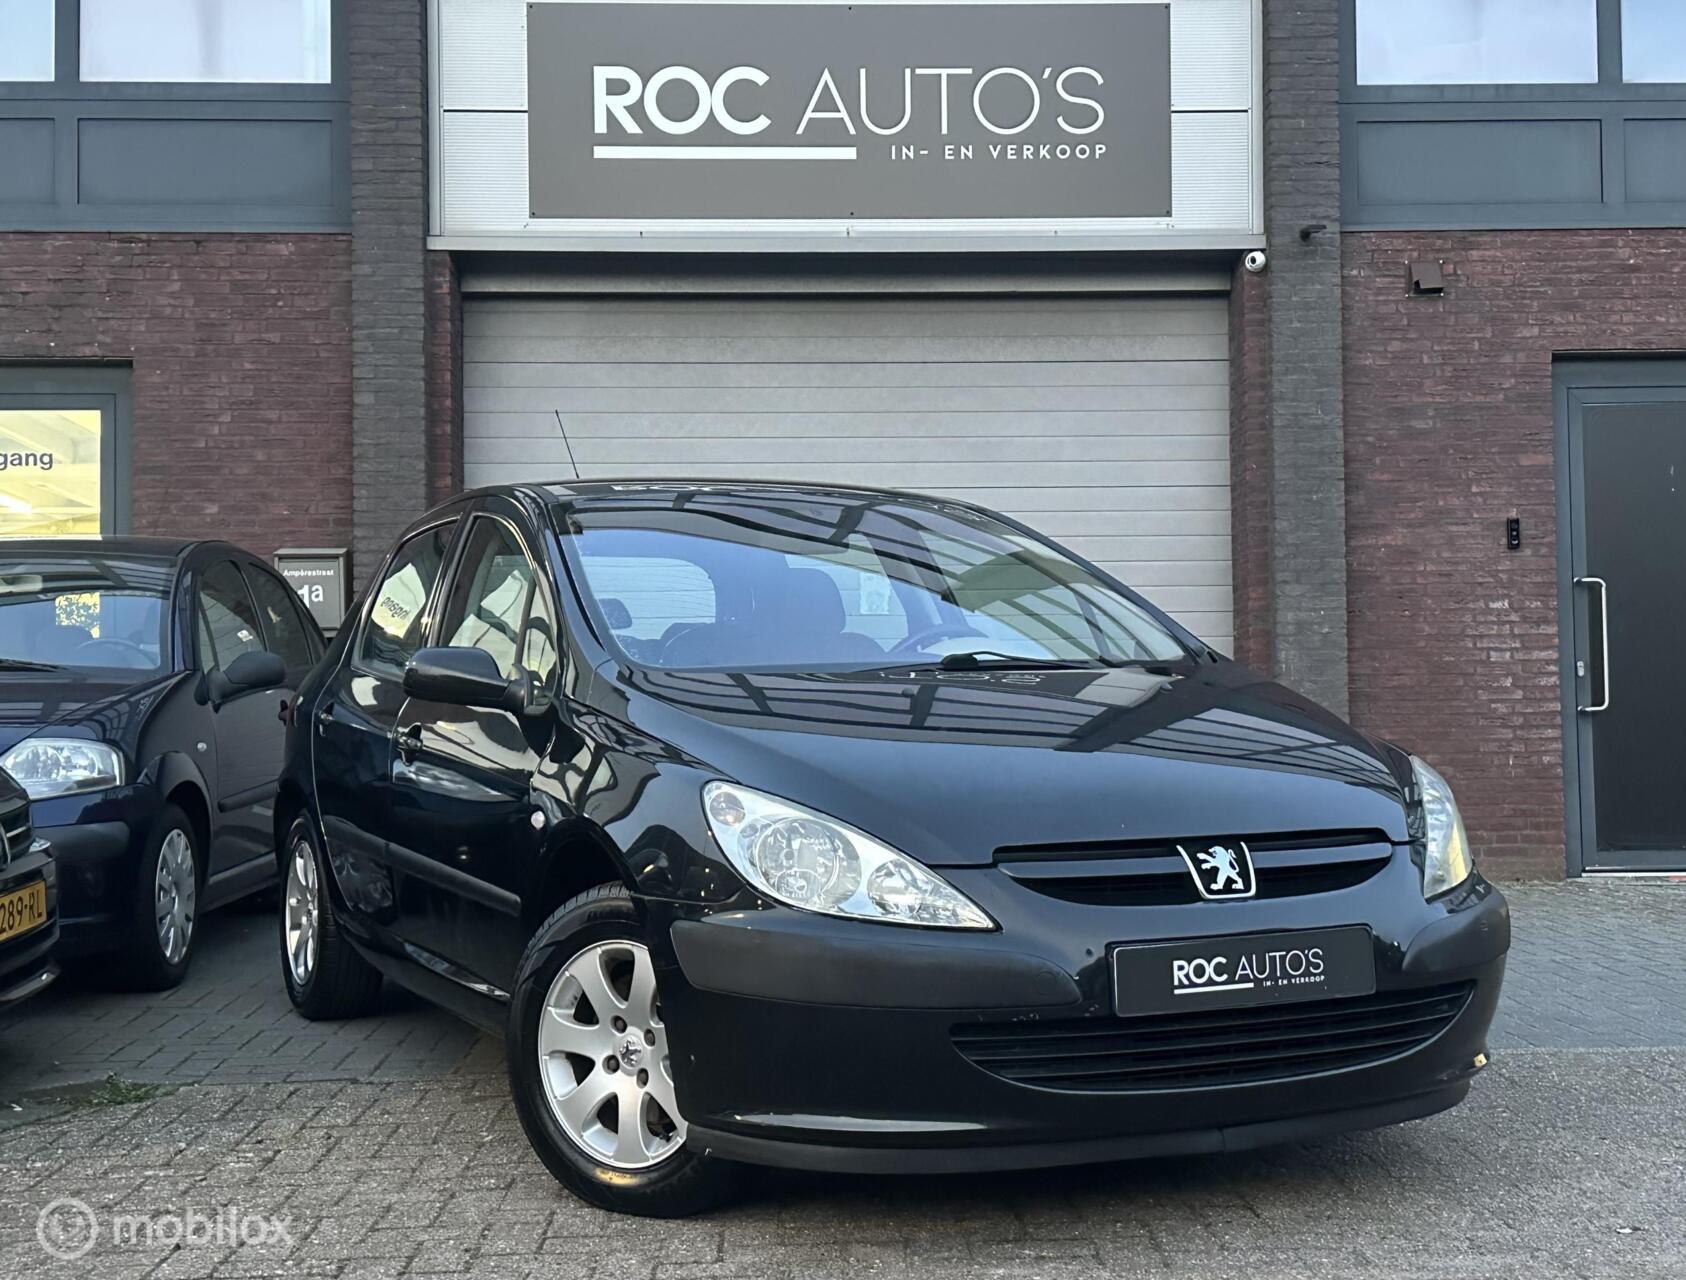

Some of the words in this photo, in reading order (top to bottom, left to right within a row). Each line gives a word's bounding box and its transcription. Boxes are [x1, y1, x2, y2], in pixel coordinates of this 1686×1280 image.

[594, 65, 772, 135] ROC
[796, 66, 1105, 136] AUTO'S
[891, 145, 929, 160] IN-
[944, 145, 973, 160] EN
[988, 144, 1107, 160] VERKOOP
[0, 452, 53, 471] gang
[297, 584, 324, 609] 1a
[1173, 956, 1229, 986] ROC
[1235, 948, 1325, 980] AUTO'S
[1290, 975, 1325, 984] VERKOOP
